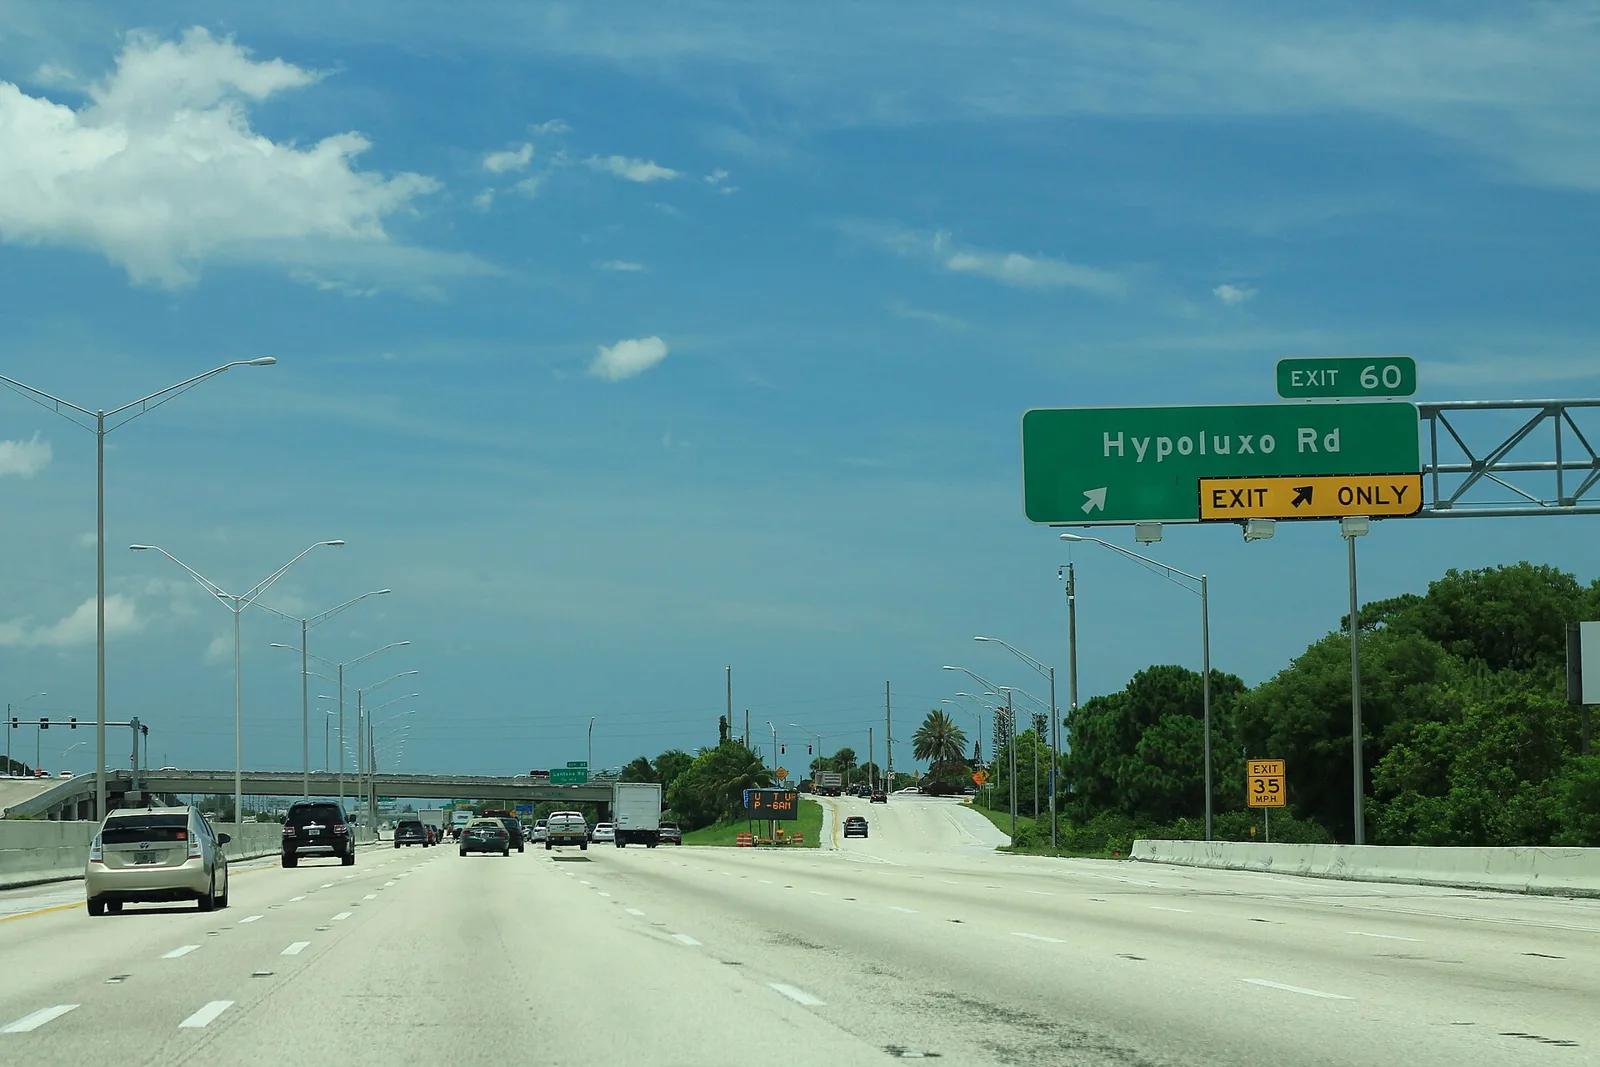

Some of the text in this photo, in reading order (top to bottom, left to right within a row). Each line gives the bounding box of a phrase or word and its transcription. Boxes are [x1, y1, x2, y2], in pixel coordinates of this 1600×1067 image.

[1291, 364, 1402, 389] EXIT 60
[1103, 427, 1341, 463] Hypoluxo Rd
[1212, 484, 1409, 509] EXIT ONLY
[1254, 765, 1278, 774] EXIT
[1253, 779, 1280, 794] 35
